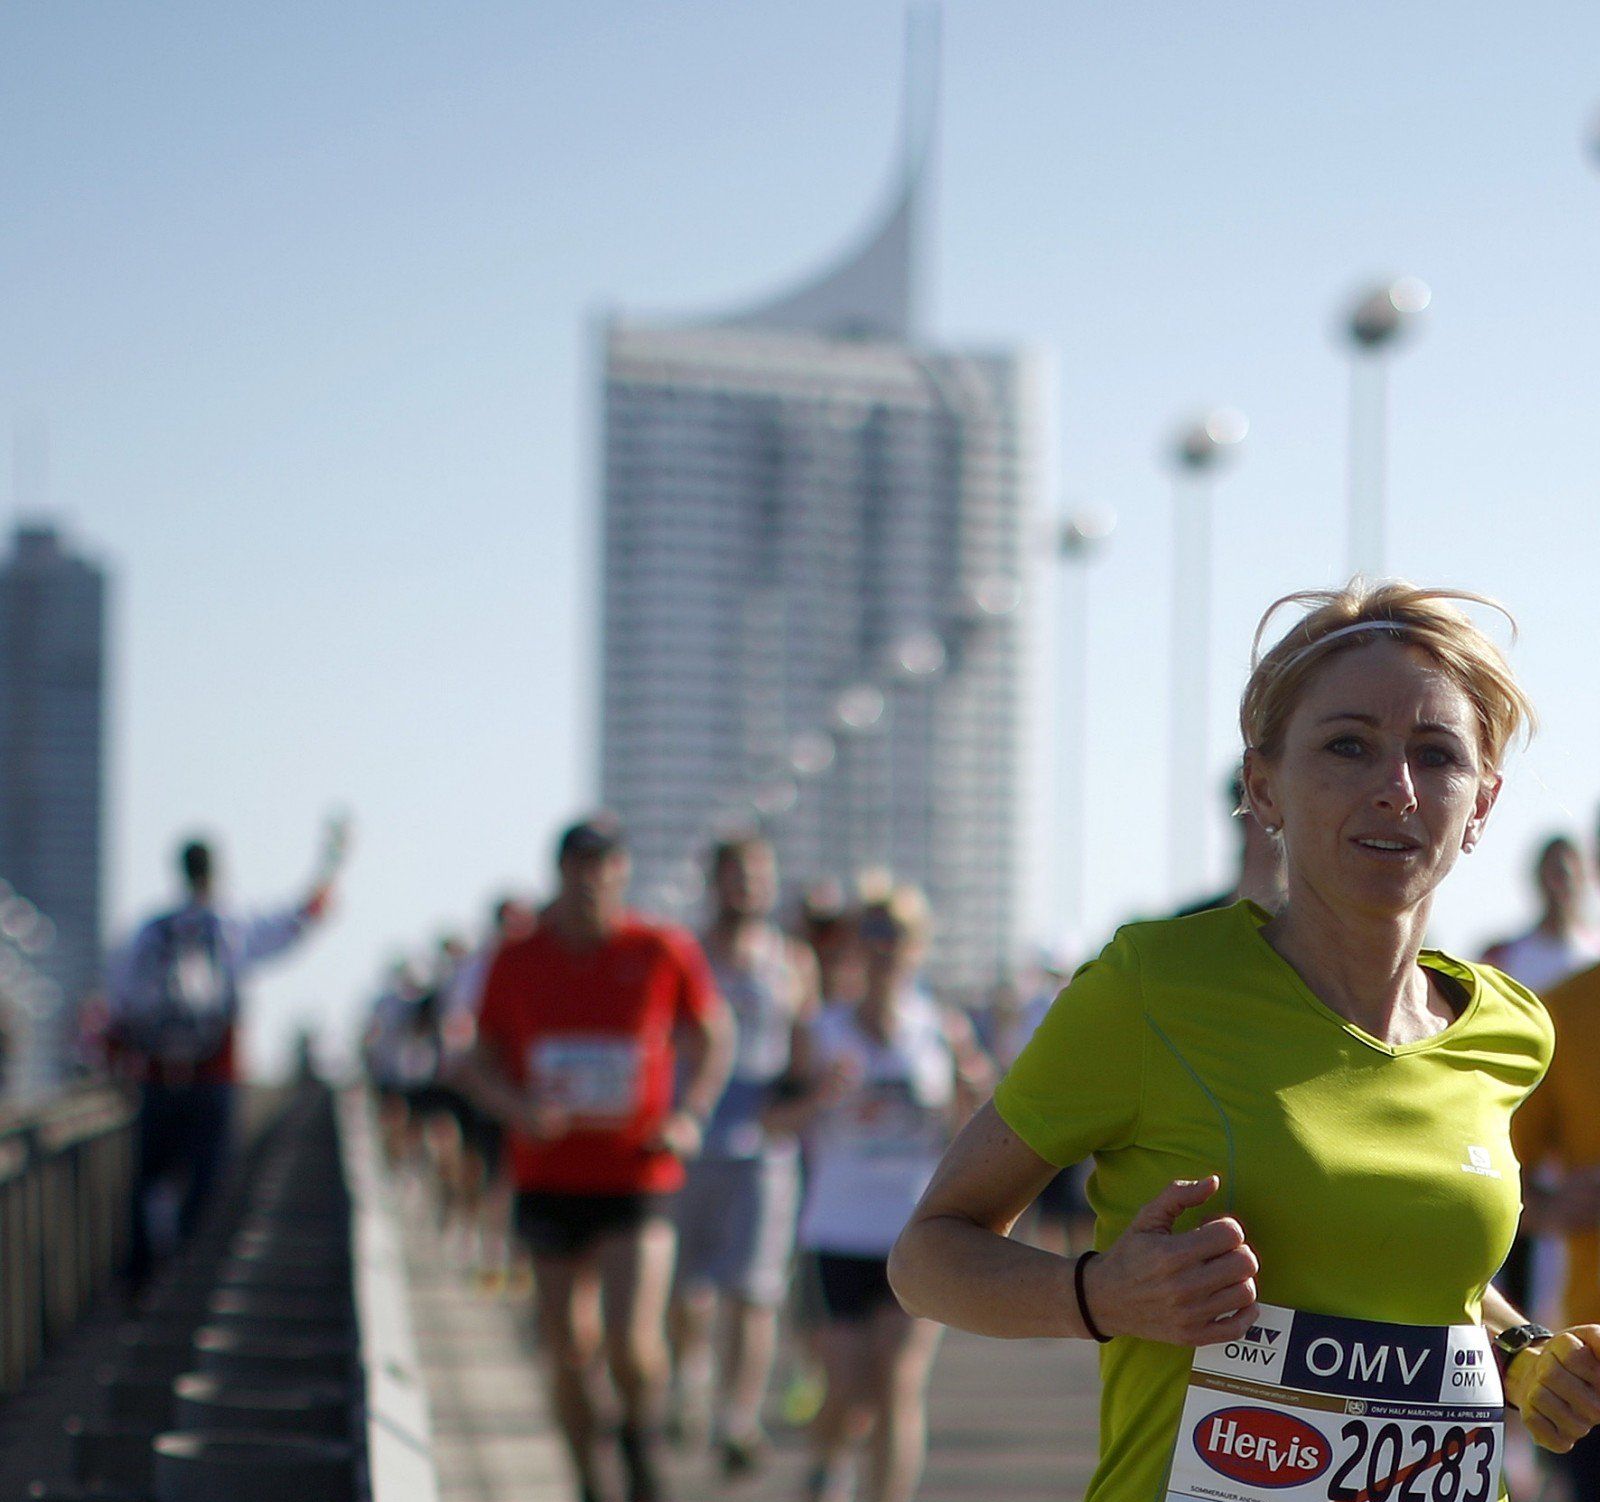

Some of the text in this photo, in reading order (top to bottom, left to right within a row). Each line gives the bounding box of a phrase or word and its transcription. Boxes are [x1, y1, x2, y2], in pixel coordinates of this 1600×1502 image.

[1225, 1343, 1276, 1366] OMV
[1305, 1337, 1430, 1386] OMV
[1452, 1371, 1486, 1387] OMV
[1407, 1408, 1444, 1418] MARATHON
[1457, 1410, 1475, 1419] APRIL
[1207, 1416, 1320, 1472] Hervis
